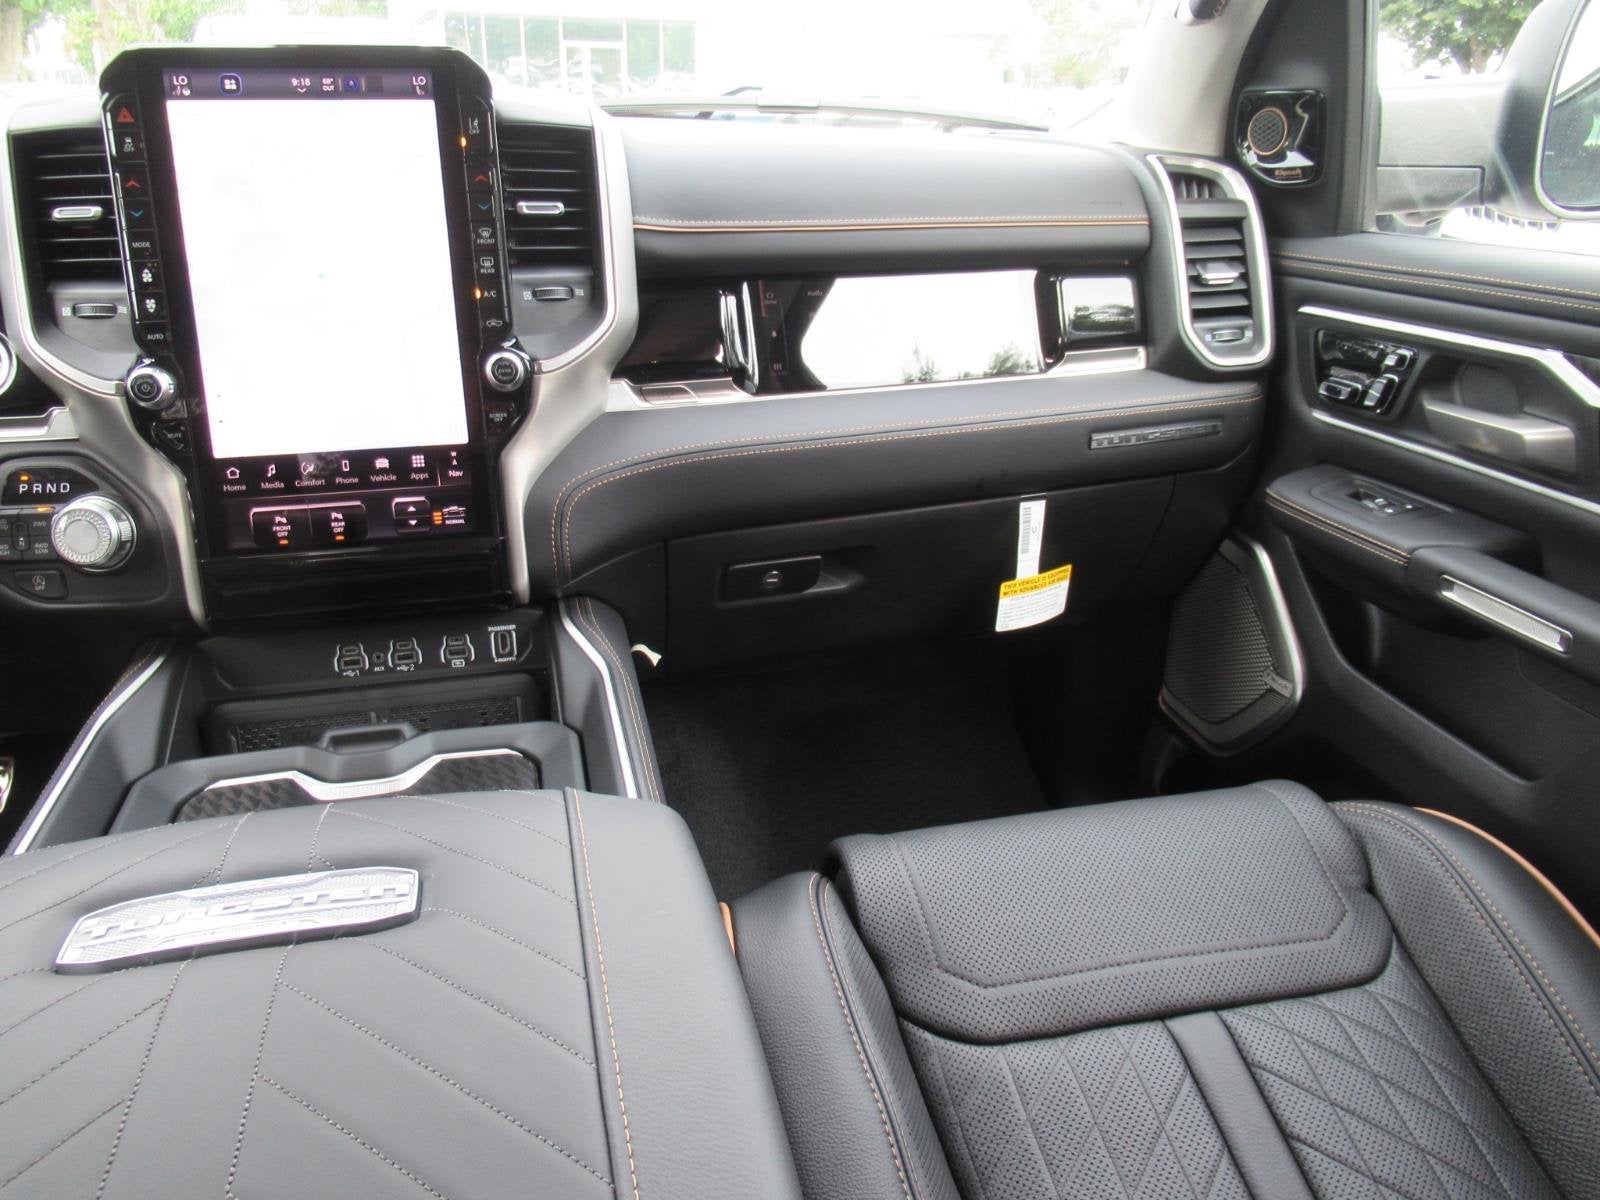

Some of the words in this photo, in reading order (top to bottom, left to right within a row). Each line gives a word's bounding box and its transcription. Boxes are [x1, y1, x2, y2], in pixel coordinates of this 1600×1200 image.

[173, 75, 188, 85] LO
[412, 75, 427, 86] LO
[483, 290, 497, 298] A/C
[223, 484, 247, 492] Home
[261, 481, 285, 489] Media
[295, 479, 325, 487] Comfort
[370, 474, 397, 482] Vehicle
[410, 472, 429, 480] Apps
[448, 470, 463, 478] Nav
